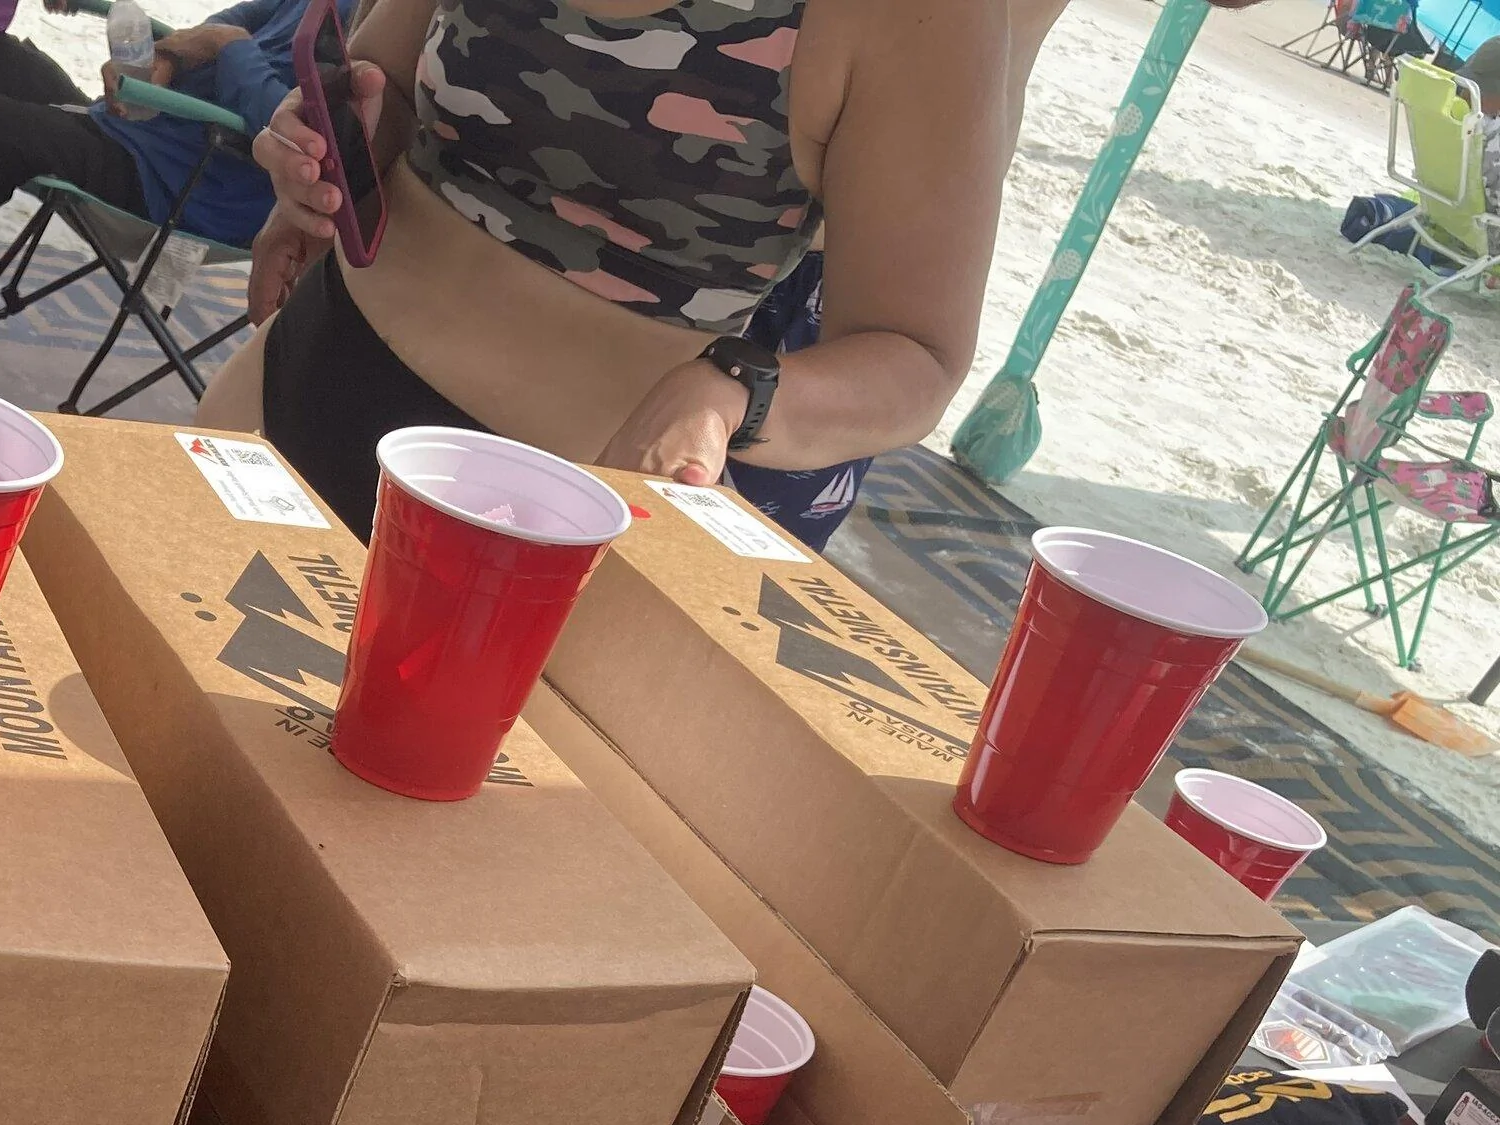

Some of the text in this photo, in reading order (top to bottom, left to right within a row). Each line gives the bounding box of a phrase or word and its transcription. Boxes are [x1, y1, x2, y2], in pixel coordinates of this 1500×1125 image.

[274, 717, 307, 738] IN
[847, 710, 954, 763] MADE IN
[882, 715, 936, 744] USA
